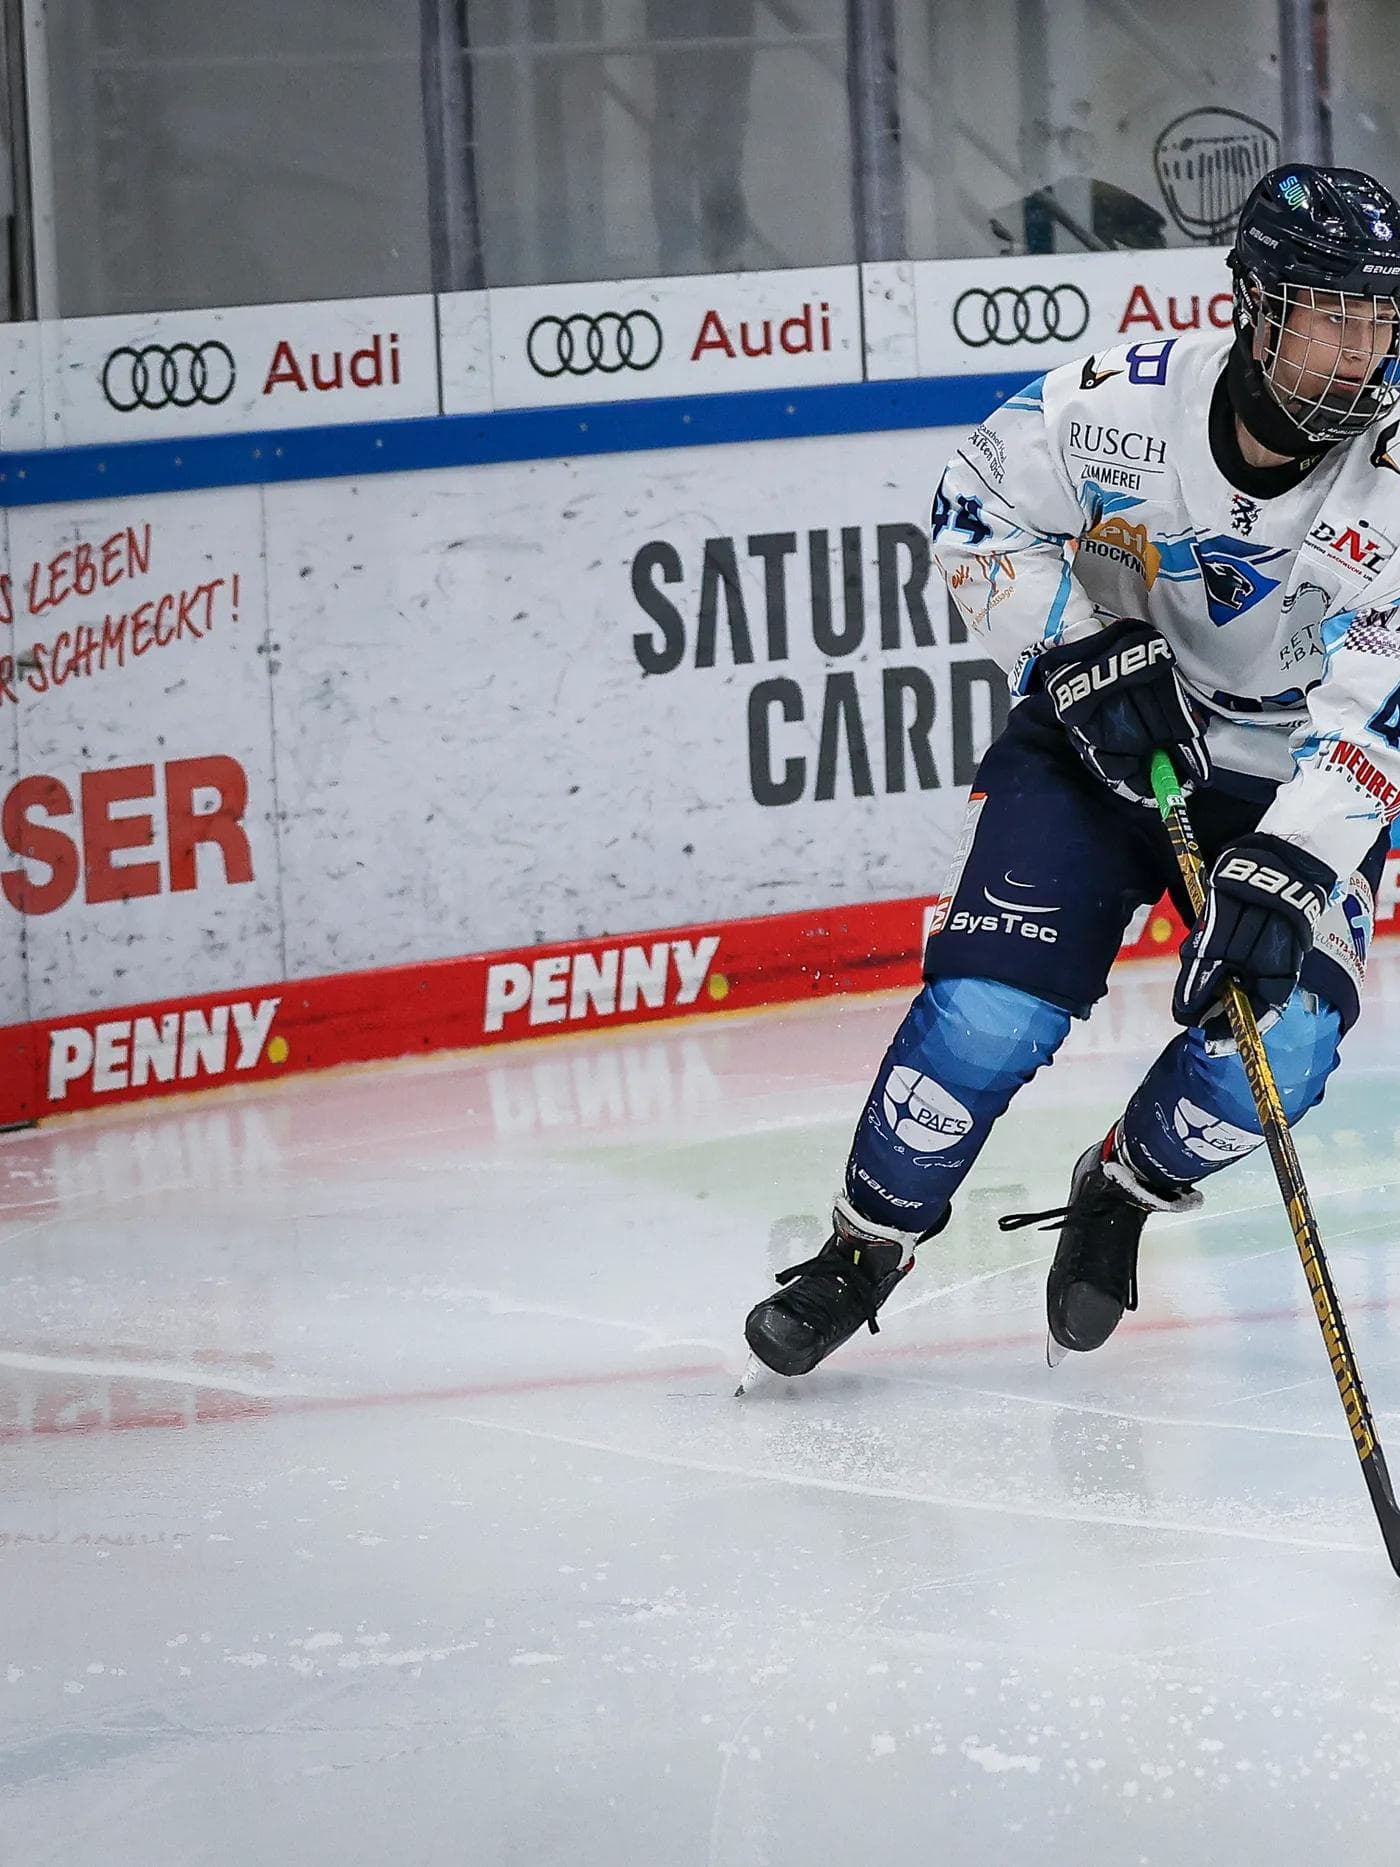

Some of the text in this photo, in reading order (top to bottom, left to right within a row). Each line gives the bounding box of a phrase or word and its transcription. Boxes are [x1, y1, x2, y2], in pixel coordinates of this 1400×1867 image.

[263, 333, 400, 394] Audi
[690, 303, 831, 361] Audi
[1070, 421, 1167, 464] RUSCH
[29, 523, 152, 615] LEBEN
[631, 521, 968, 676] SATUR
[27, 572, 242, 693] SCHMECKT!
[747, 657, 1011, 808] CARD
[949, 911, 1059, 944] SysTec
